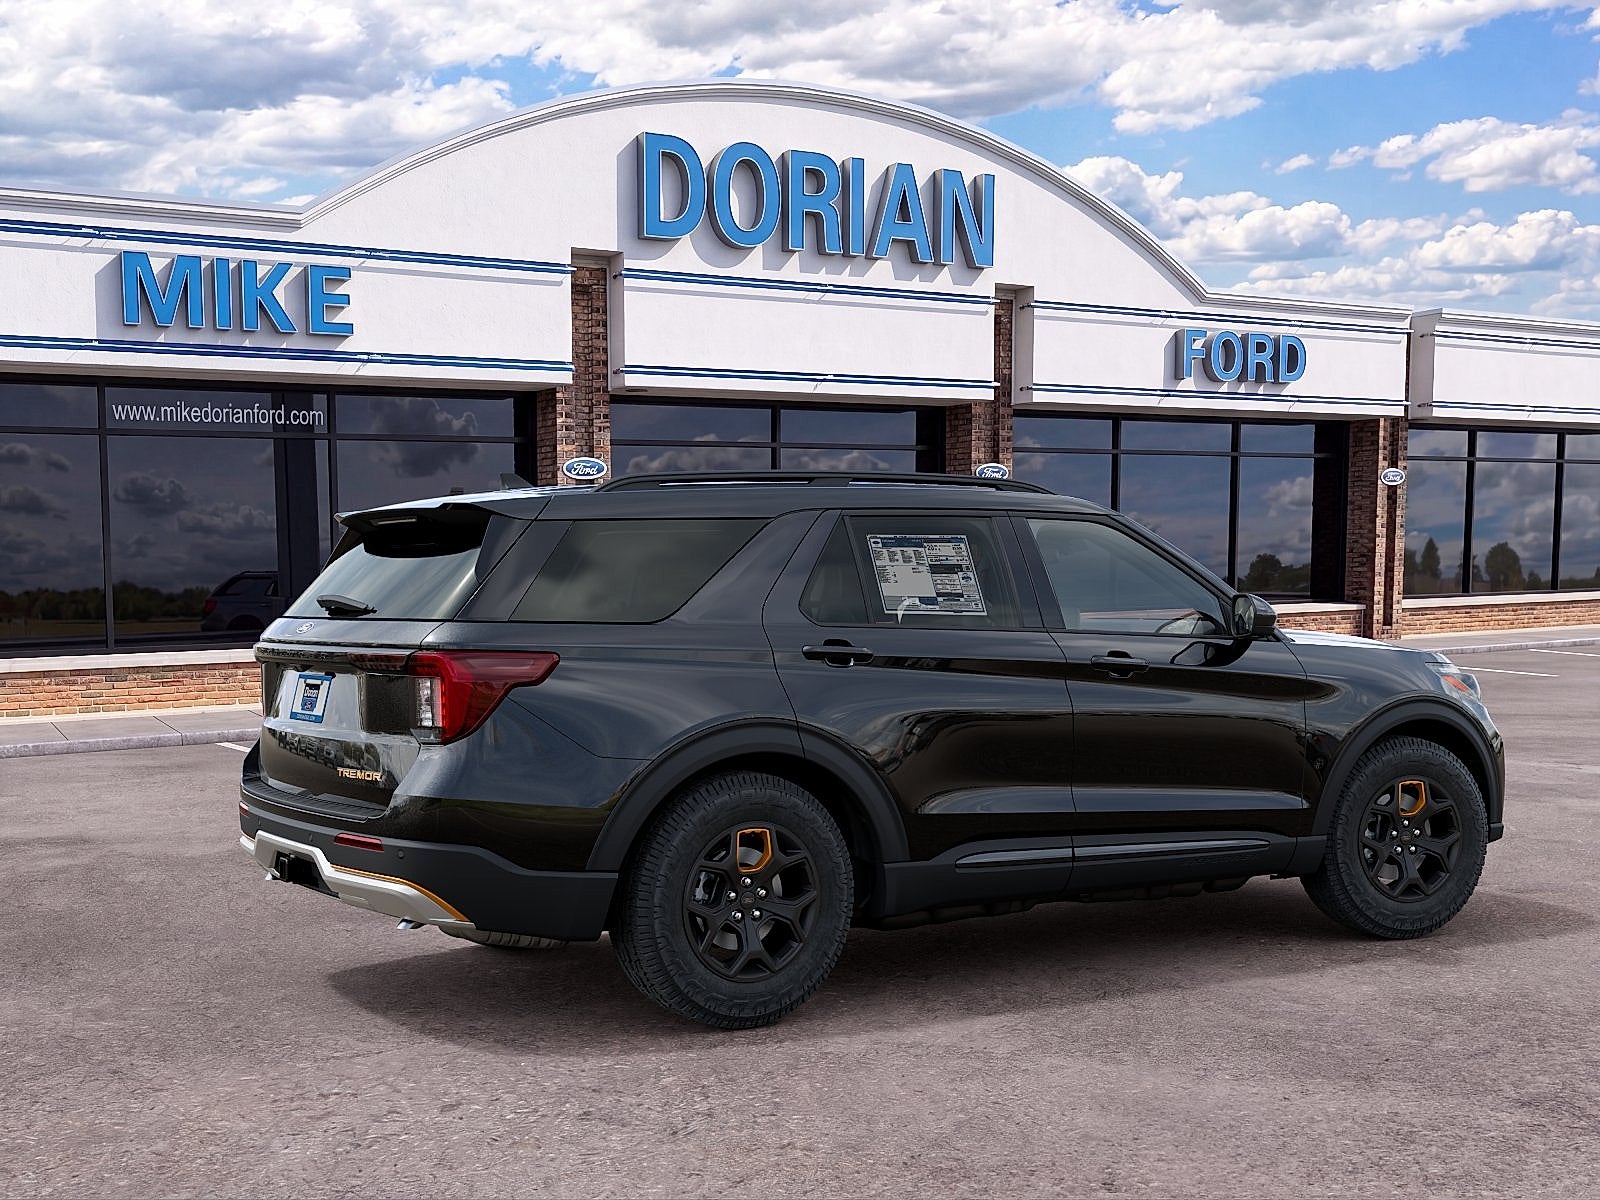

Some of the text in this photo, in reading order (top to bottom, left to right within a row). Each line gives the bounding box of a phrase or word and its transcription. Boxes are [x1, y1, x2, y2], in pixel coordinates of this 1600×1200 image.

[638, 131, 996, 268] DORIAN
[121, 250, 354, 335] MIKE
[1176, 328, 1307, 383] FORD
[112, 401, 324, 426] www.mikedorianford.com
[571, 462, 599, 475] Ford
[336, 766, 383, 782] TREMOR
